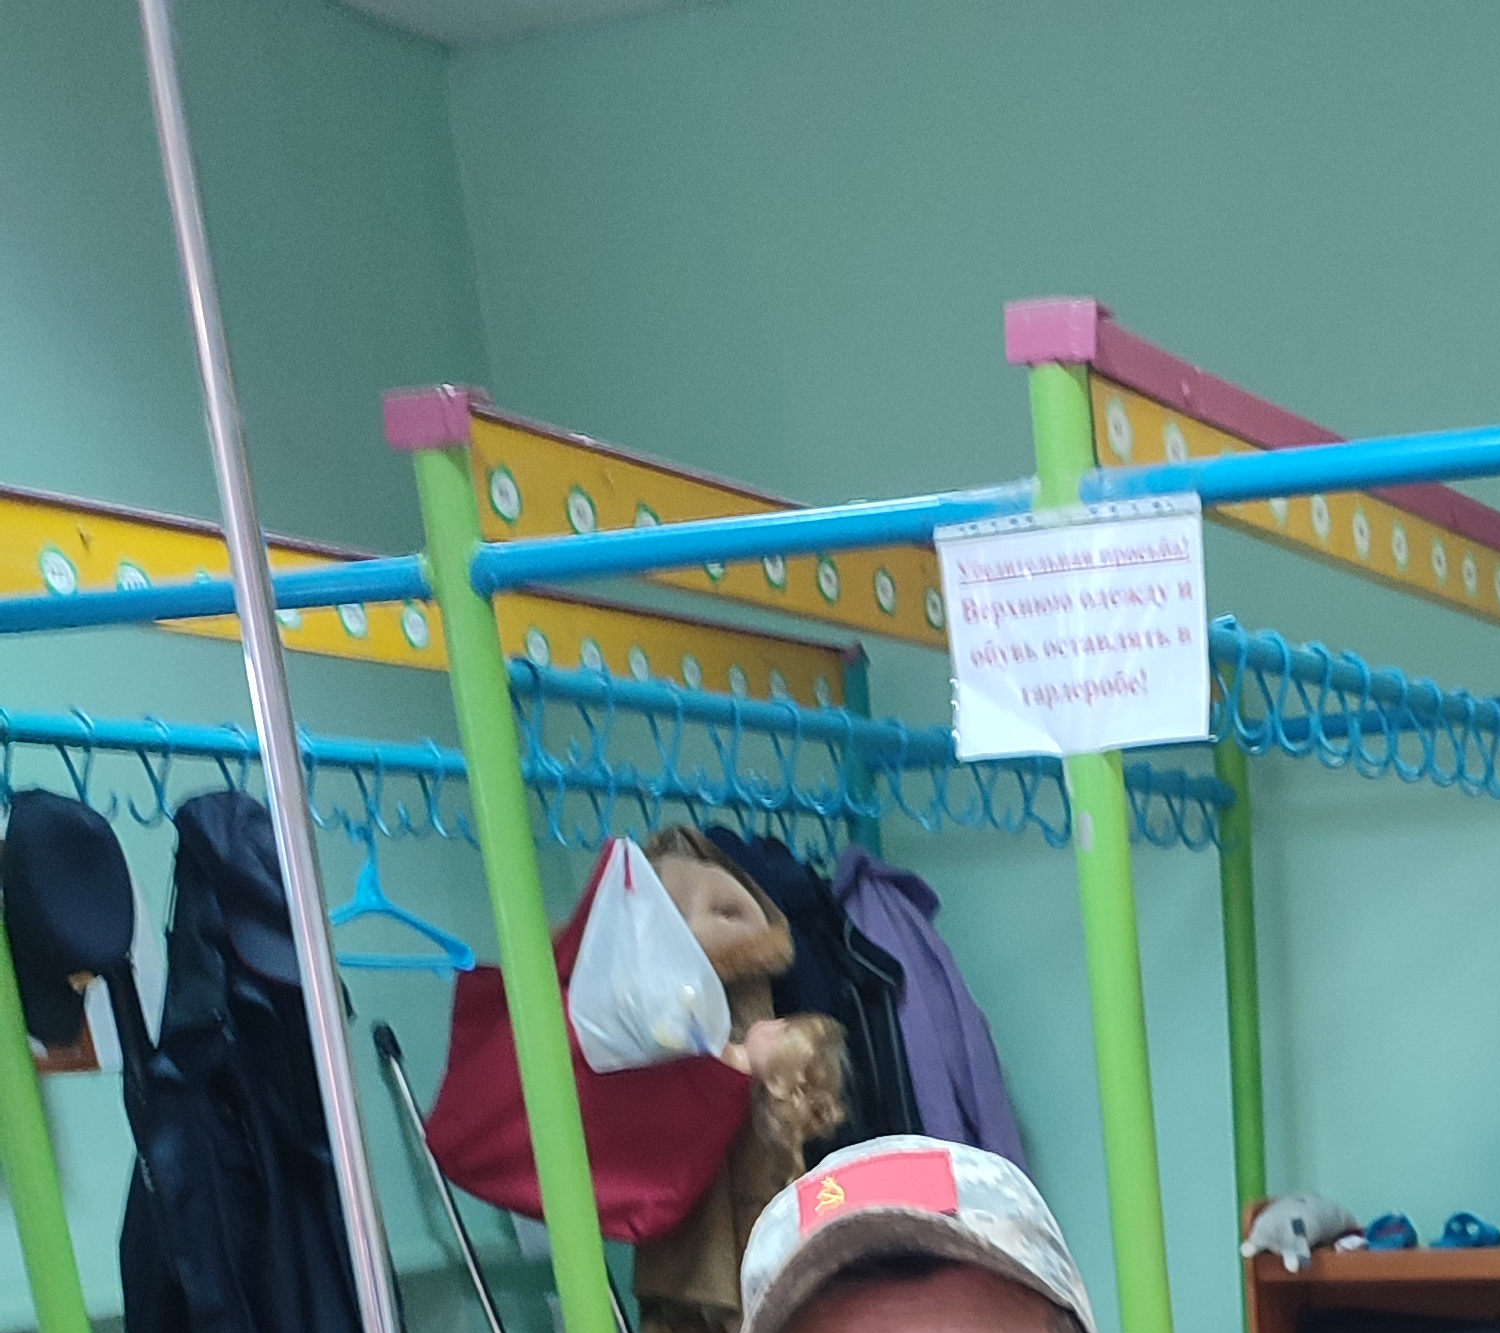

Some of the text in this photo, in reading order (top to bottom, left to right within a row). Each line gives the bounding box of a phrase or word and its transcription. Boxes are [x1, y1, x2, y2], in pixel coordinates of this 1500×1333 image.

[962, 591, 1072, 628] Верхнюю
[1080, 584, 1167, 609] одежду
[1177, 580, 1193, 600] и
[970, 626, 1192, 669] обувь оставлять в
[1021, 669, 1148, 709] гардеробе!
